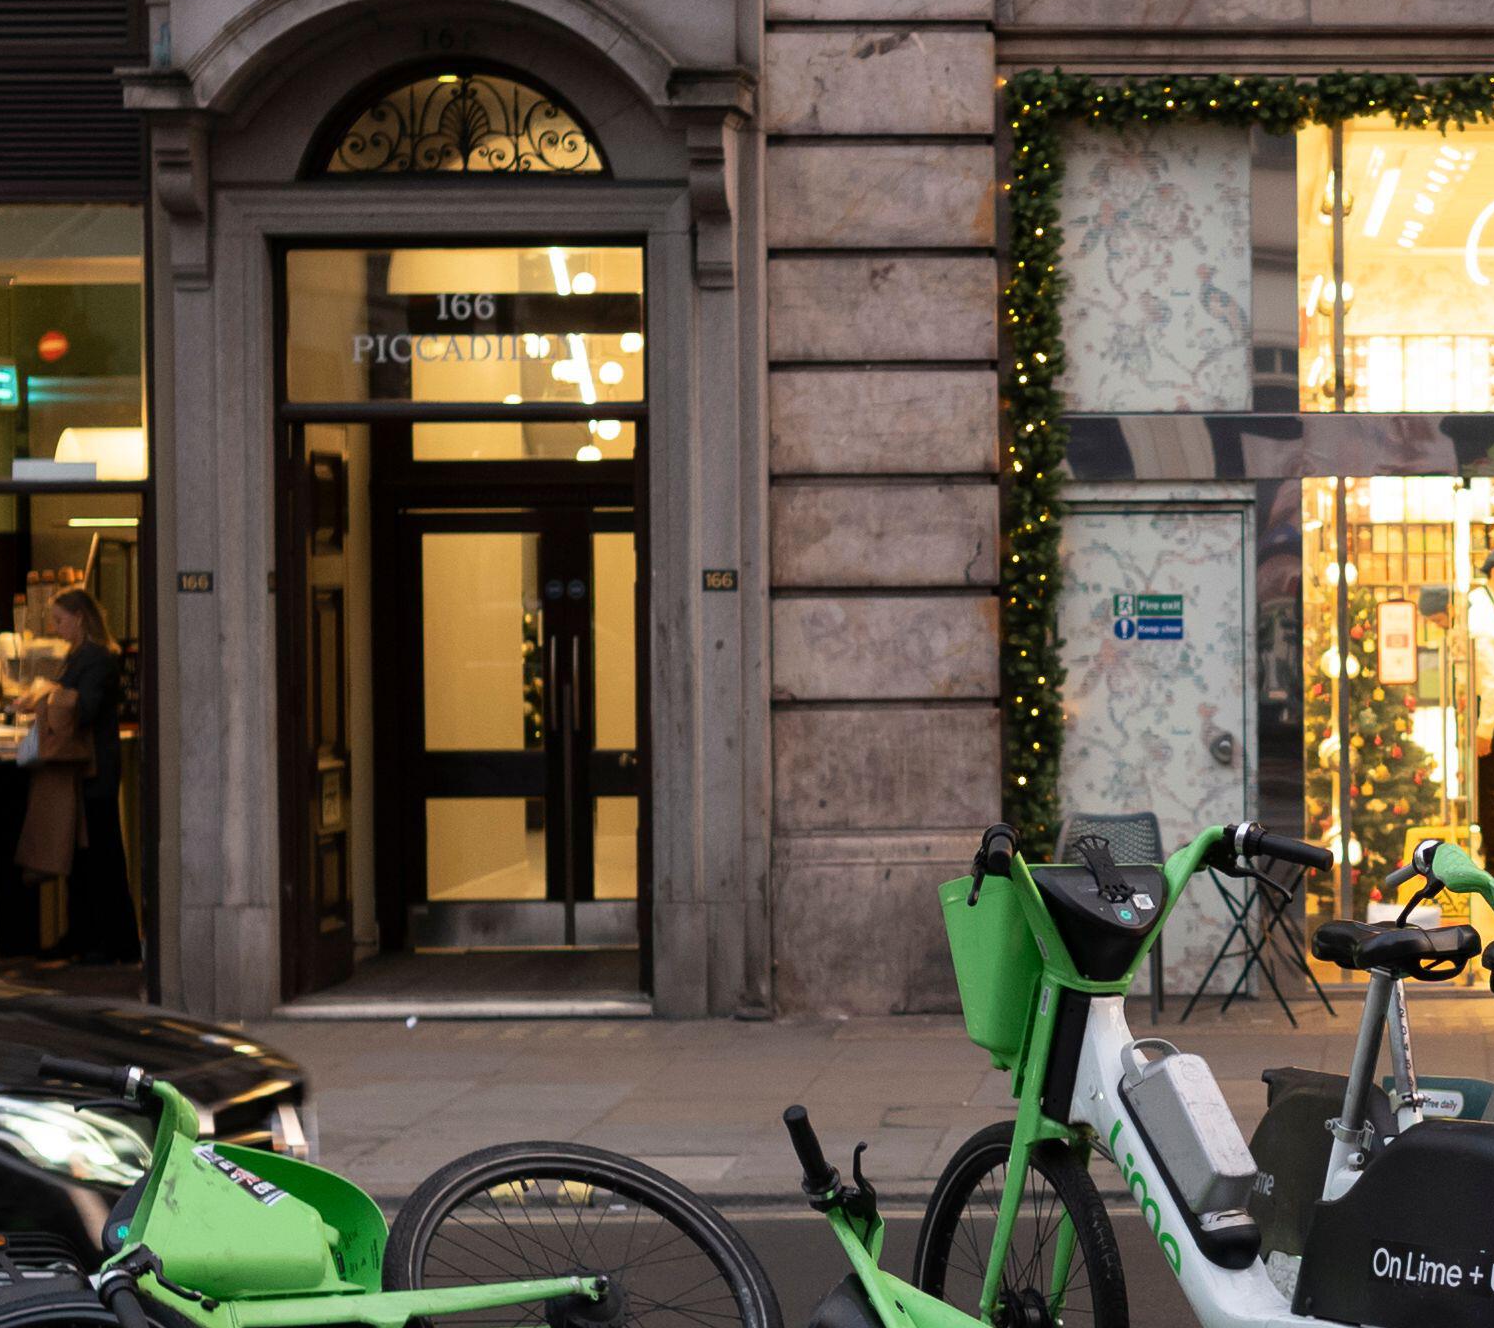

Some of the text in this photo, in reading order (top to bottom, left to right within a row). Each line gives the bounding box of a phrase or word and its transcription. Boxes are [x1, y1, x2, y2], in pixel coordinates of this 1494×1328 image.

[436, 294, 496, 321] 166
[1161, 600, 1181, 611] exit
[1372, 1247, 1401, 1280] On
[1404, 1250, 1463, 1288] Lime
[1469, 1271, 1484, 1285] +
